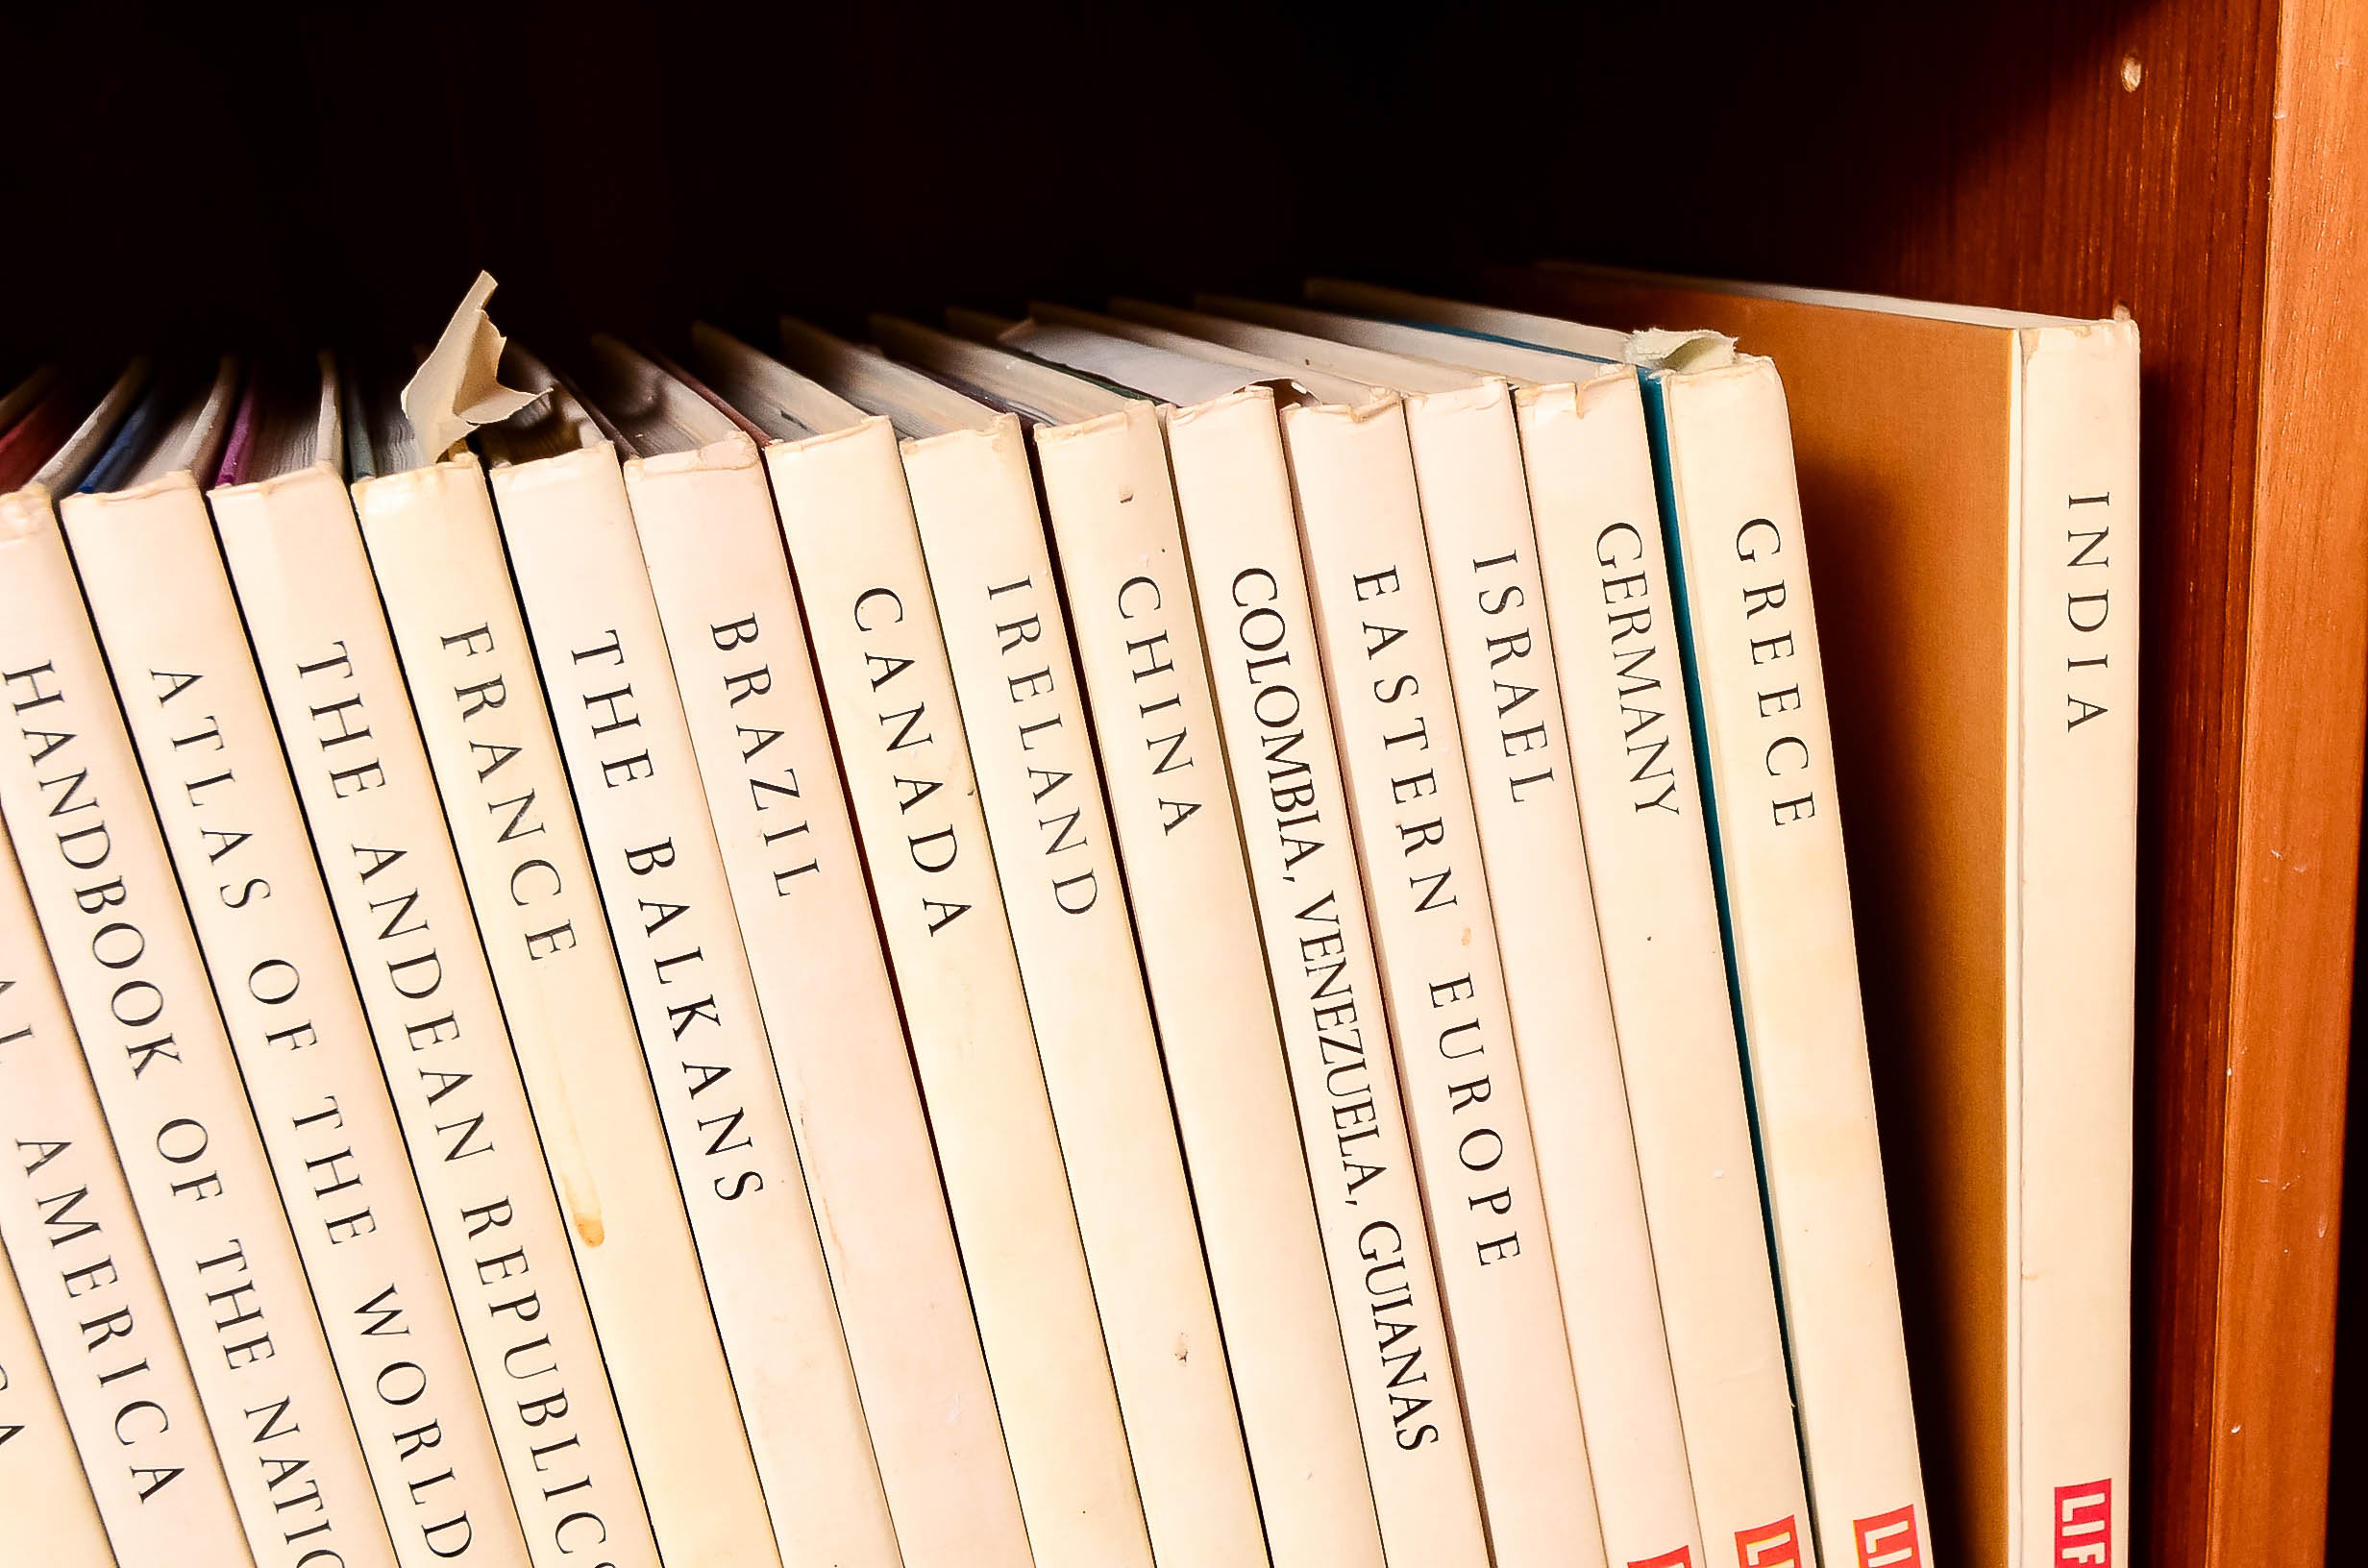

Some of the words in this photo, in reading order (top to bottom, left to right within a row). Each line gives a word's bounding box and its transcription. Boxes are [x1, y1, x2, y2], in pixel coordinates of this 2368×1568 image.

[709, 611, 821, 897] BRAZIL
[853, 587, 973, 938] CANADA
[986, 575, 1098, 915] IRELAND
[1118, 576, 1202, 837] CHINA
[1472, 549, 1555, 803] ISRAEL
[1596, 522, 1680, 816] GERMANY
[1736, 518, 1815, 827] GREECE
[2066, 491, 2110, 733] INDIA
[439, 622, 578, 962] FRANCE
[570, 628, 654, 789] THE
[624, 836, 764, 1201] BALKANS
[1352, 564, 1458, 913] EASTERN
[1428, 971, 1521, 1266] EUROPE
[0, 660, 183, 1080] HANDBOOK
[156, 1117, 223, 1202] OF
[195, 1237, 276, 1370] THE
[150, 670, 271, 909] ATLAS
[248, 959, 318, 1051] OF
[292, 1095, 377, 1245] THE
[353, 1283, 473, 1558] WORLD
[296, 640, 386, 799] THE
[351, 844, 495, 1163] ANDEAN
[460, 1195, 616, 1568] REPUBLIC
[1231, 567, 1325, 883] COLOMBIA,
[1294, 889, 1388, 1206] VENEZUELA,
[1358, 1220, 1440, 1451] GUIANAS
[15, 1139, 185, 1505] AMERICA
